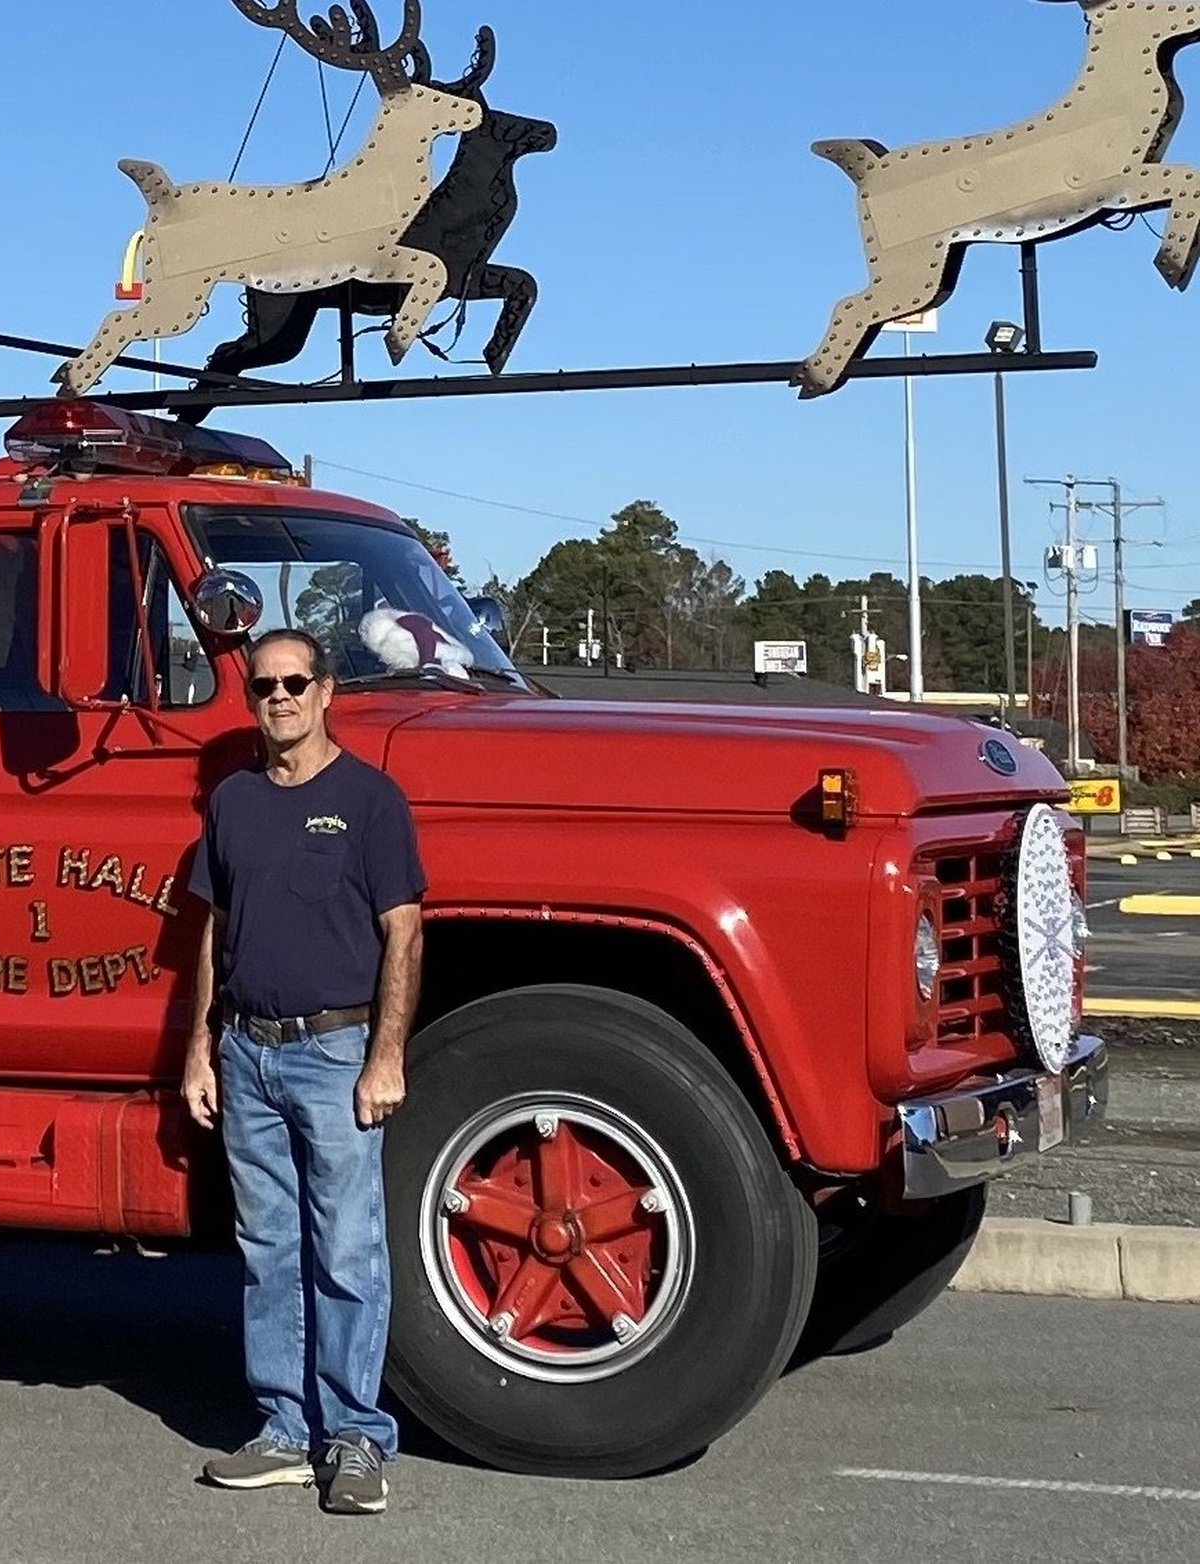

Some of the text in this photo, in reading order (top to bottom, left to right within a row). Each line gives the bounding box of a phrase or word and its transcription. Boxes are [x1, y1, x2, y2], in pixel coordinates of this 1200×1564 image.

[60, 847, 179, 916] HALL
[31, 900, 51, 940] 1
[49, 945, 160, 994] DEPT.
